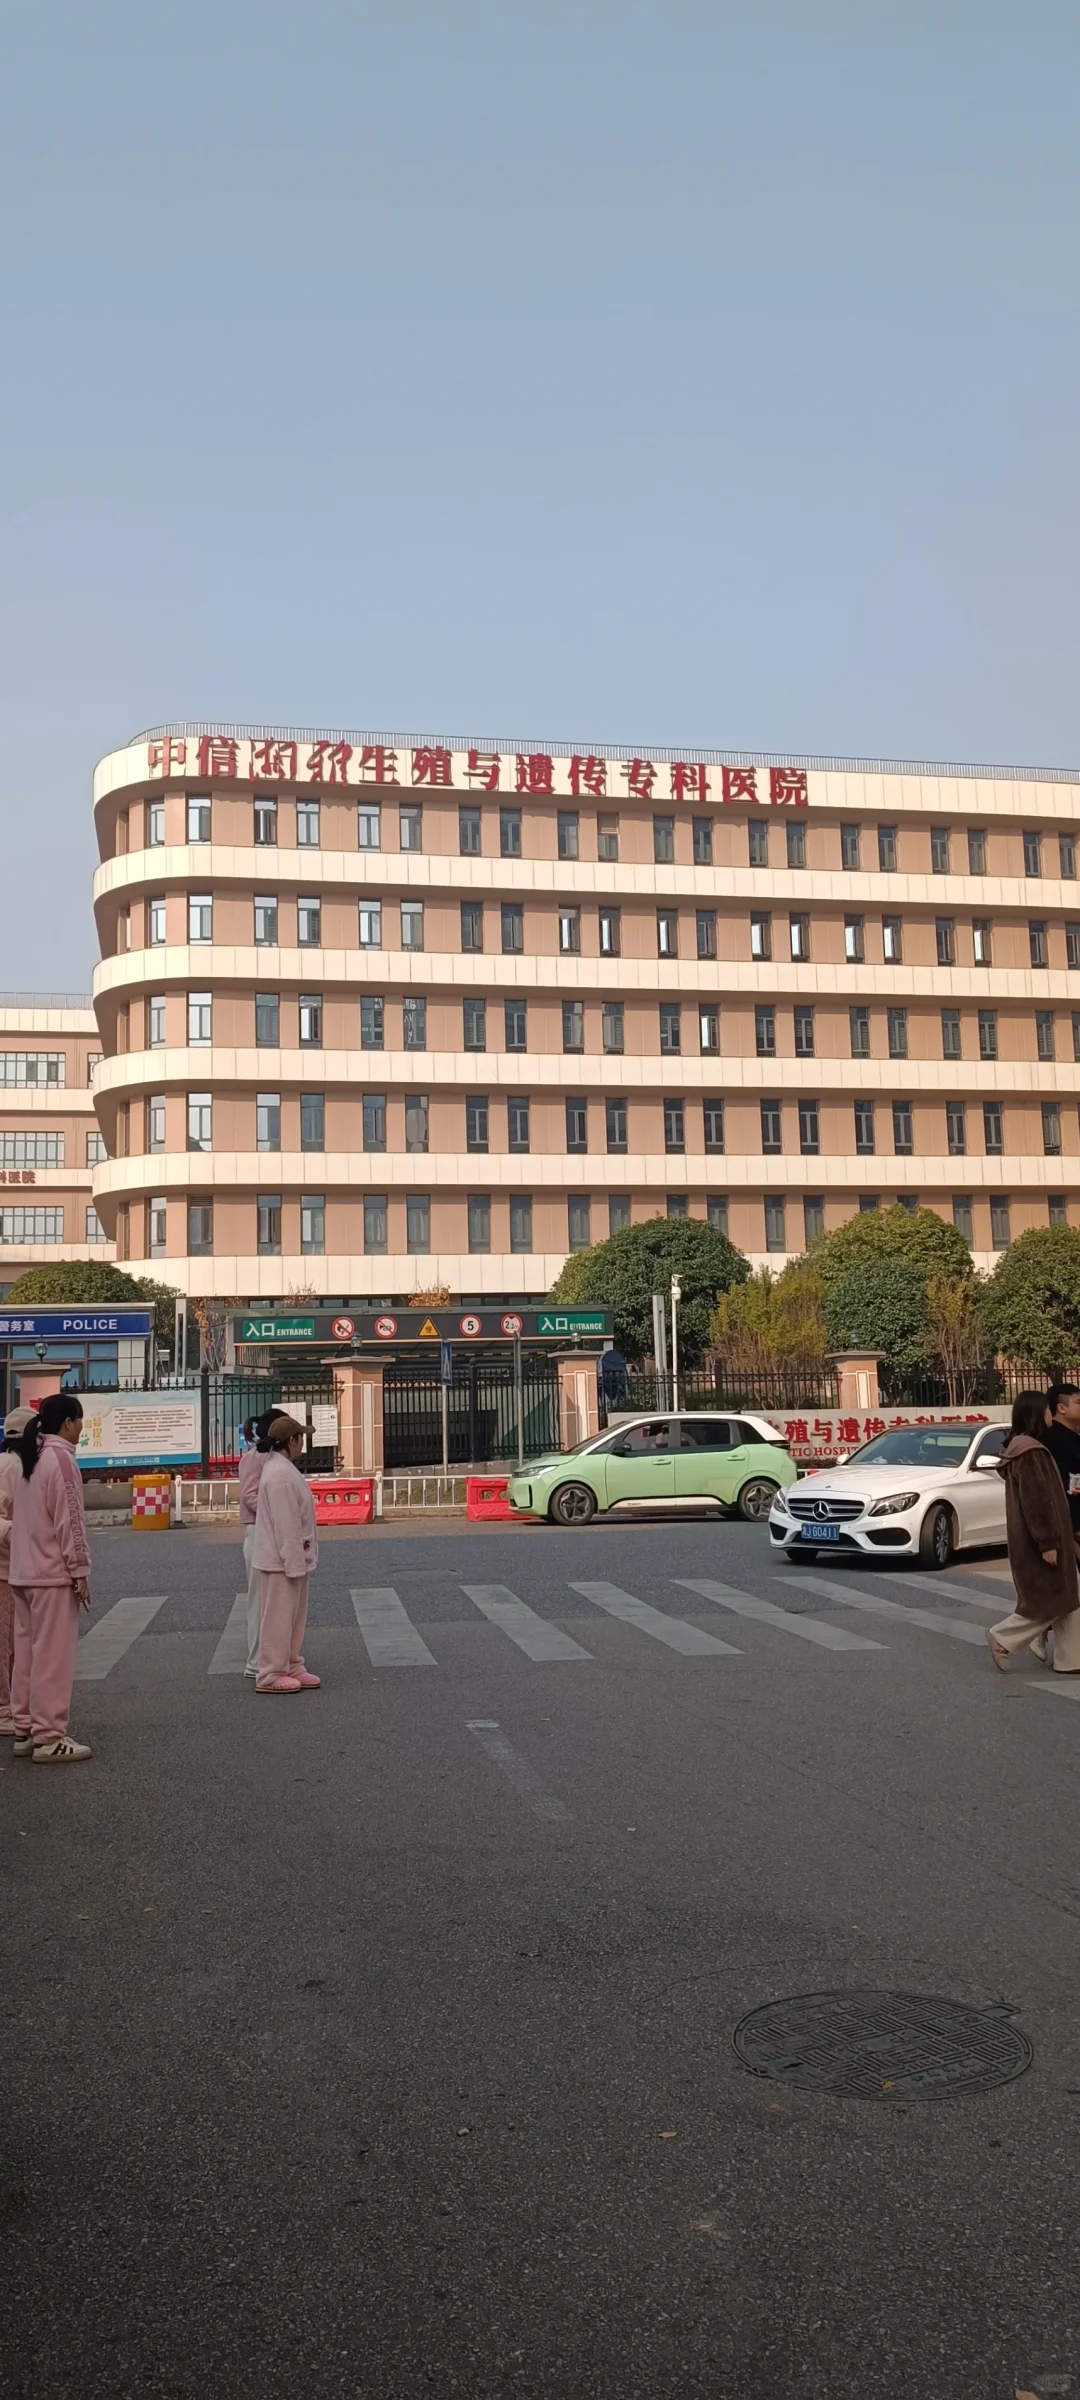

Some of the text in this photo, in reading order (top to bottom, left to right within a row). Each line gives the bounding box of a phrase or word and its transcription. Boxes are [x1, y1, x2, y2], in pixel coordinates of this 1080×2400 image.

[63, 1319, 118, 1330] POLICE
[246, 1322, 275, 1337] 入口
[467, 1320, 475, 1331] 5
[541, 1317, 568, 1331] 入口
[569, 1322, 603, 1331] ENTRANCE
[276, 1328, 313, 1336] ENTRANCE
